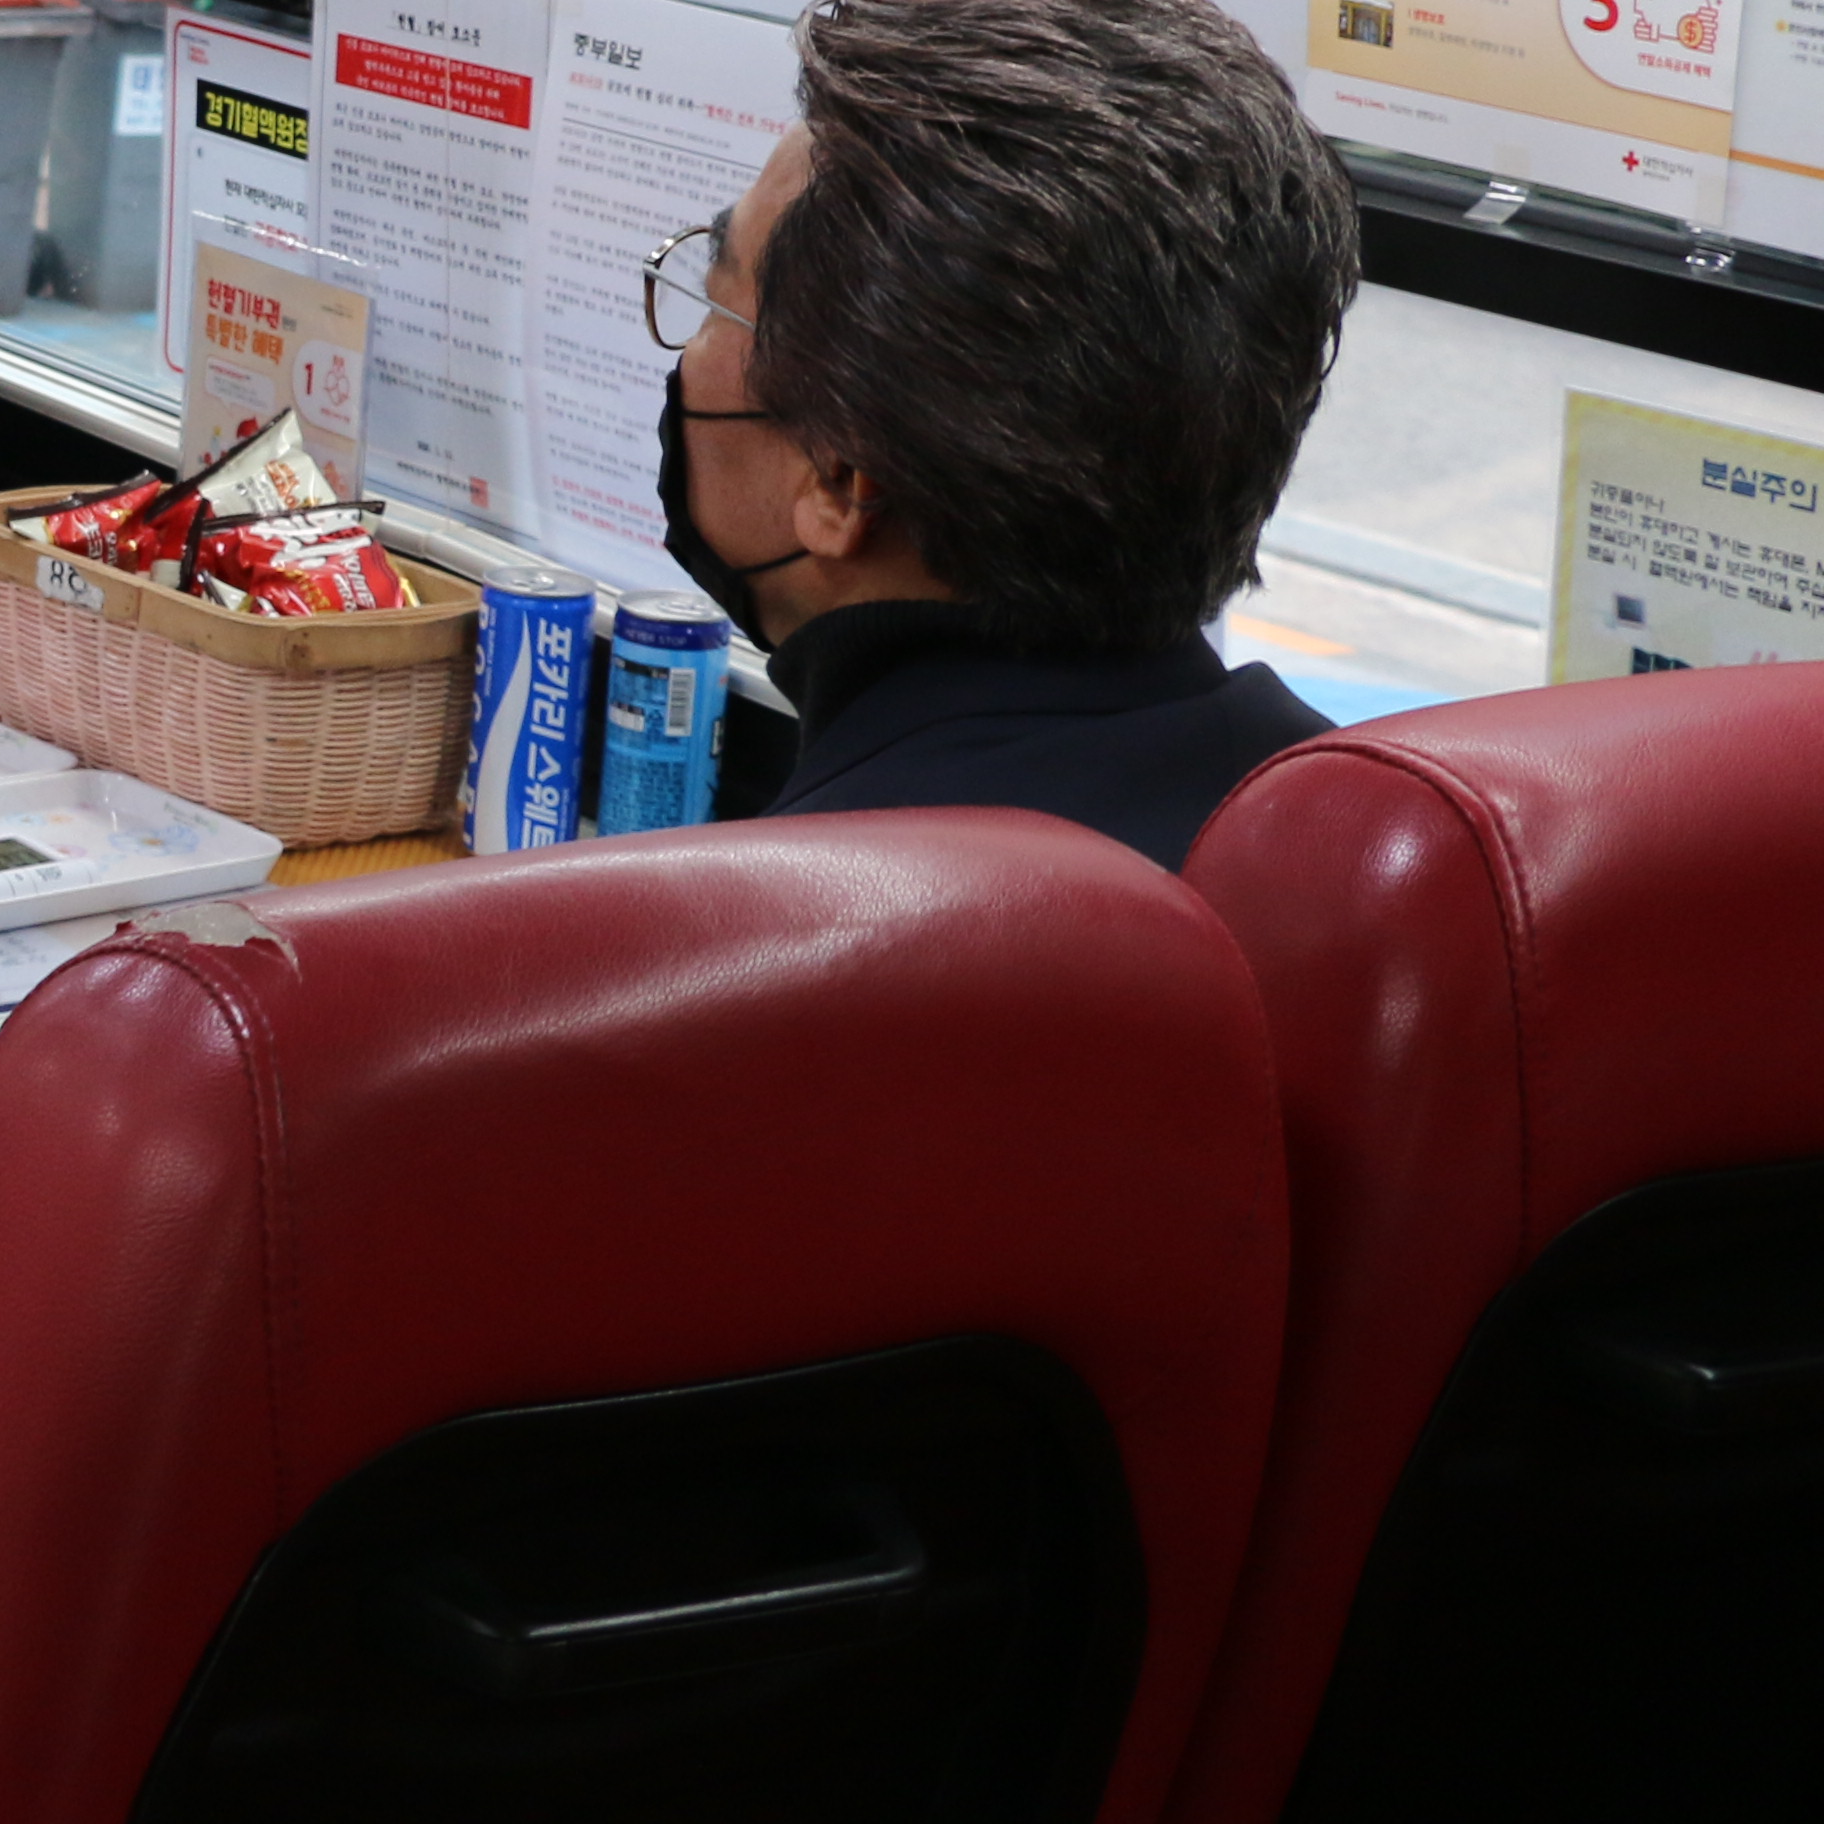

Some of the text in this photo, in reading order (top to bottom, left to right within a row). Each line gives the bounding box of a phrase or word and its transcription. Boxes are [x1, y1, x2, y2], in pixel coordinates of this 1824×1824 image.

[573, 33, 643, 71] 중부일보
[207, 279, 280, 330] 헌혈기부권
[206, 314, 284, 366] 특별한 혜택
[304, 363, 314, 396] 1
[1702, 457, 1818, 513] 분실주의
[1589, 501, 1632, 527] 본인이
[1587, 522, 1647, 552] 분실되지
[1587, 543, 1616, 565] 분실
[1622, 553, 1637, 570] 시
[659, 633, 688, 647] STOP
